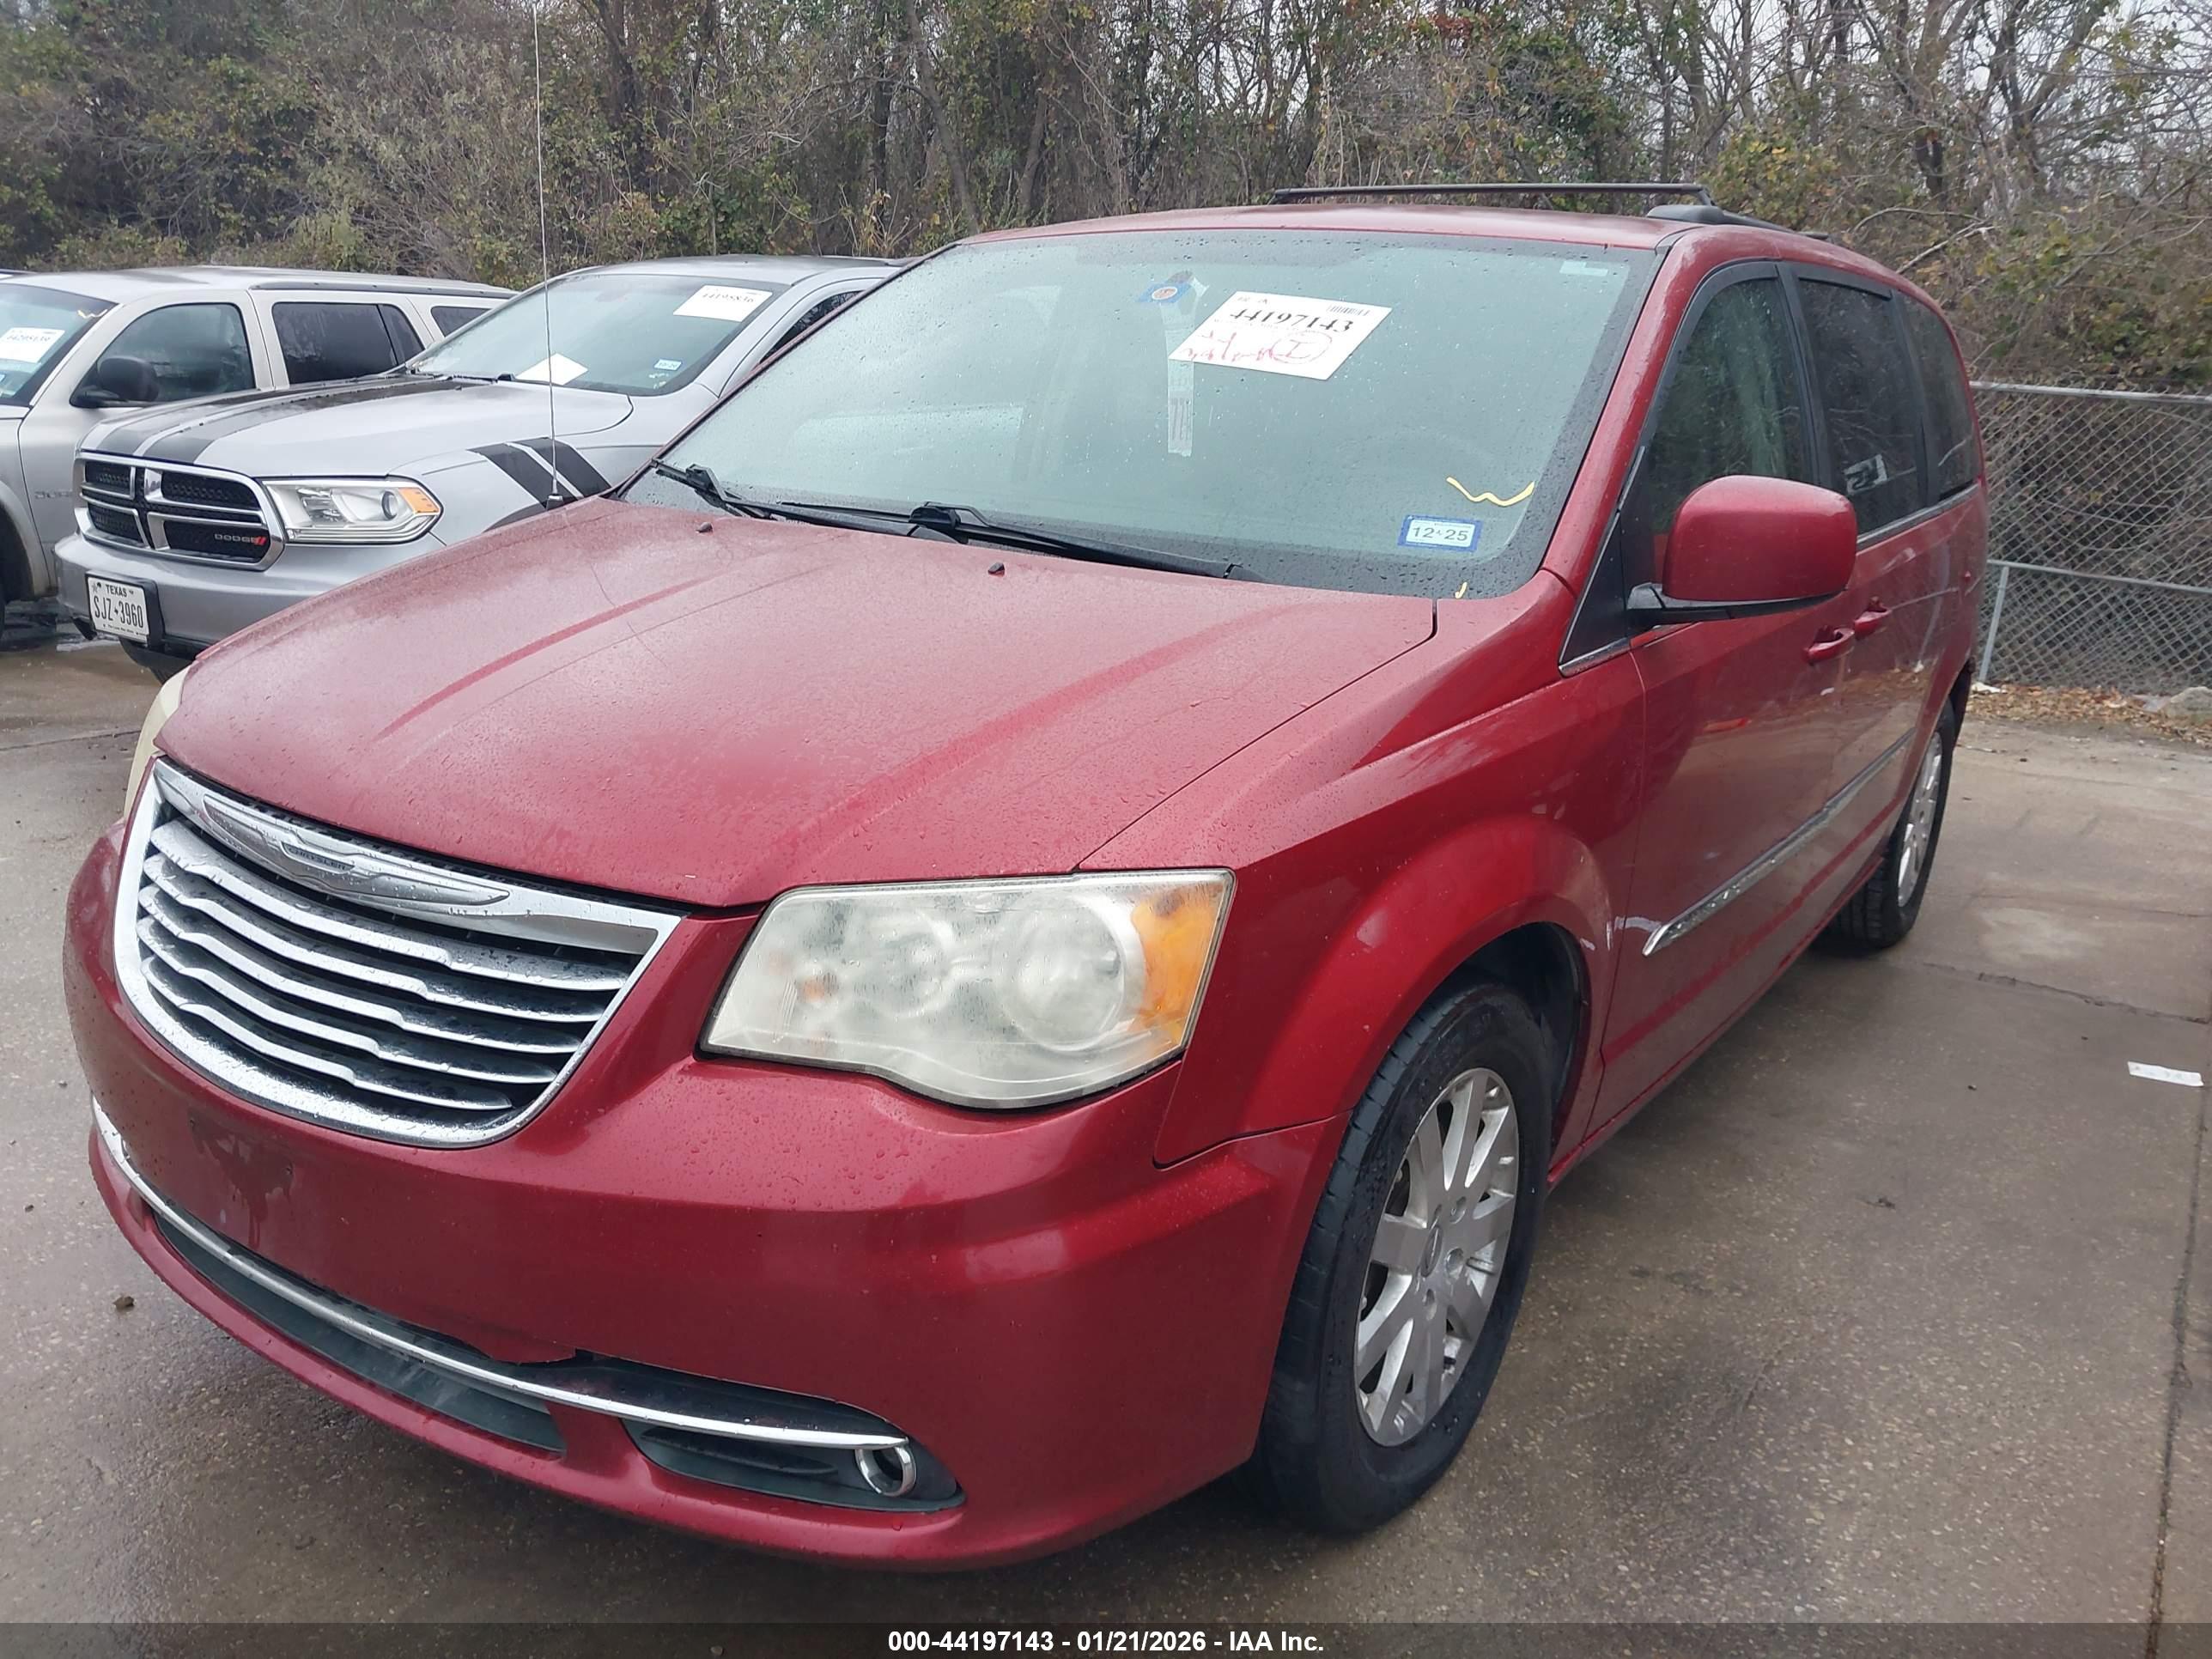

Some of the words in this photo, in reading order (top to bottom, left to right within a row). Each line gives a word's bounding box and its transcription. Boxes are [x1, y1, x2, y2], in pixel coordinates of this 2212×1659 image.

[1230, 308, 1354, 333] 44197143
[214, 533, 258, 544] DODGE
[105, 584, 128, 598] TEXAS
[288, 847, 346, 871] CHRYSLER
